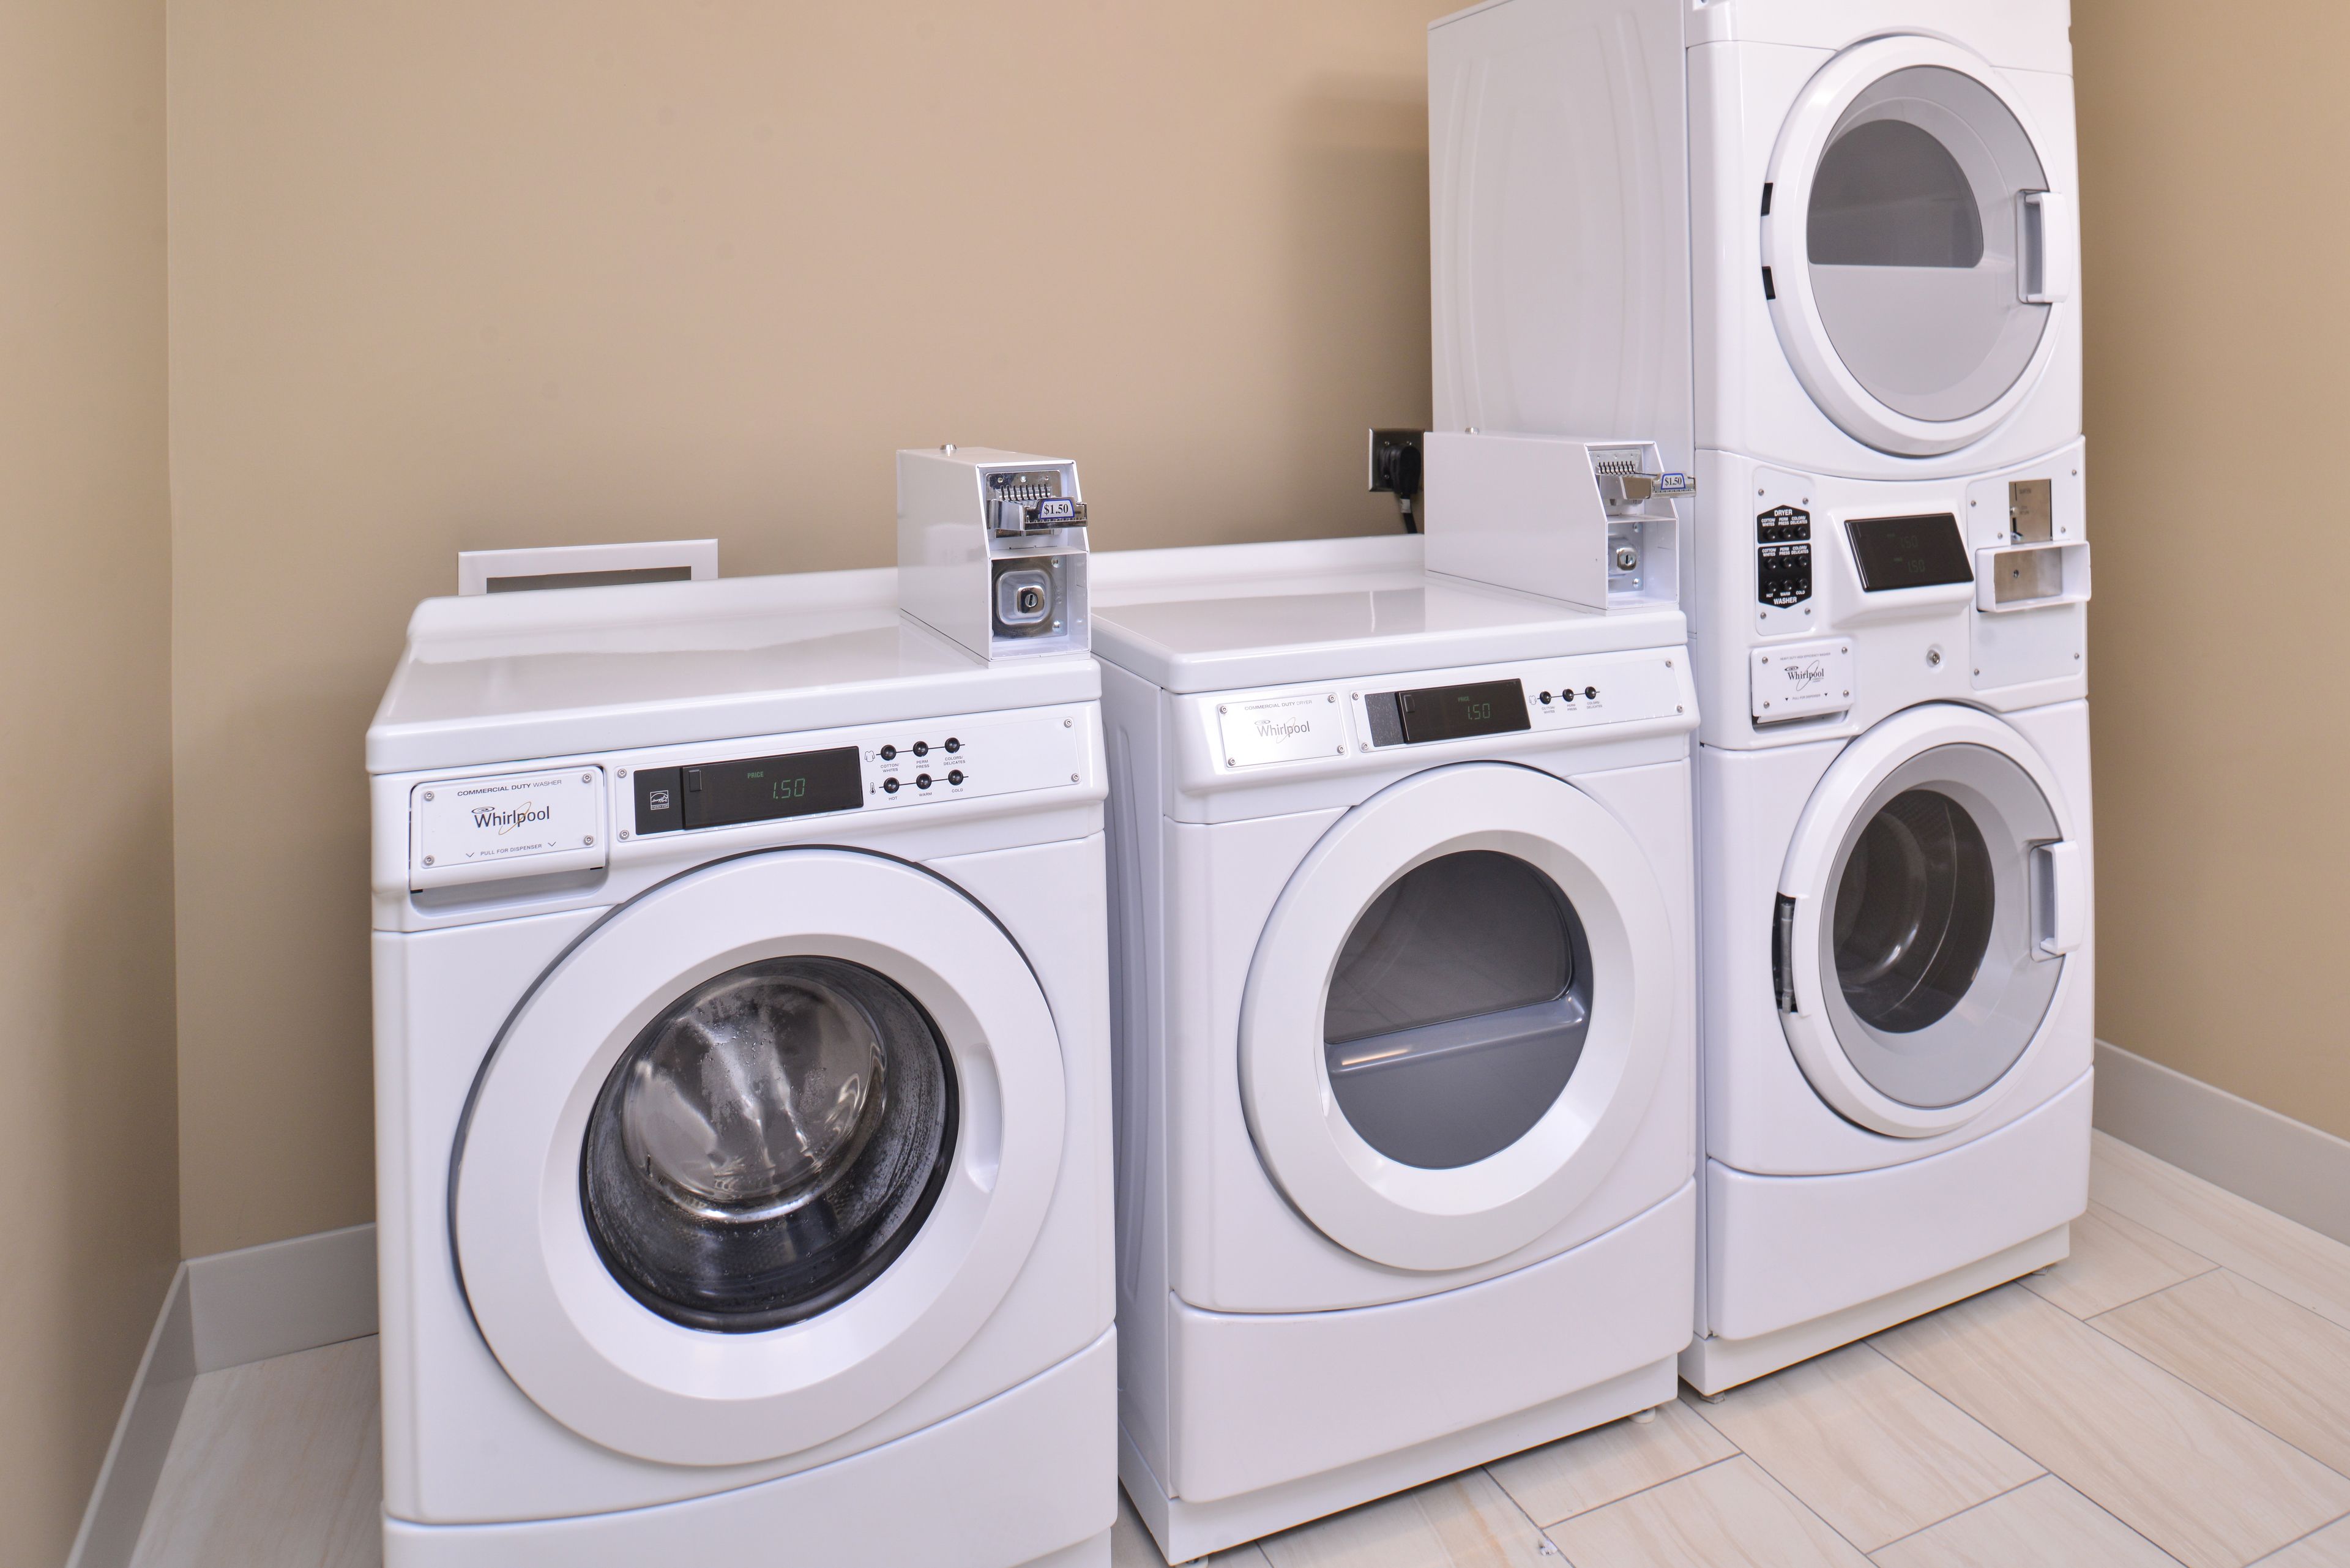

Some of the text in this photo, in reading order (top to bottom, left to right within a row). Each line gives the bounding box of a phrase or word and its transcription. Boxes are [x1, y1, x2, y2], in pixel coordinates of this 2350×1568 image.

[1665, 477, 1682, 486] $1.50
[1044, 504, 1069, 515] $1.50
[1788, 668, 1824, 681] Whirlpool
[1468, 703, 1490, 720] 1.50
[1256, 721, 1310, 737] Whirlpool
[457, 786, 509, 796] COMMERCIAL
[533, 779, 562, 788] WASHER
[773, 778, 805, 799] 1.50
[474, 806, 550, 828] Whirlpool
[510, 844, 542, 853] DISPENSER
